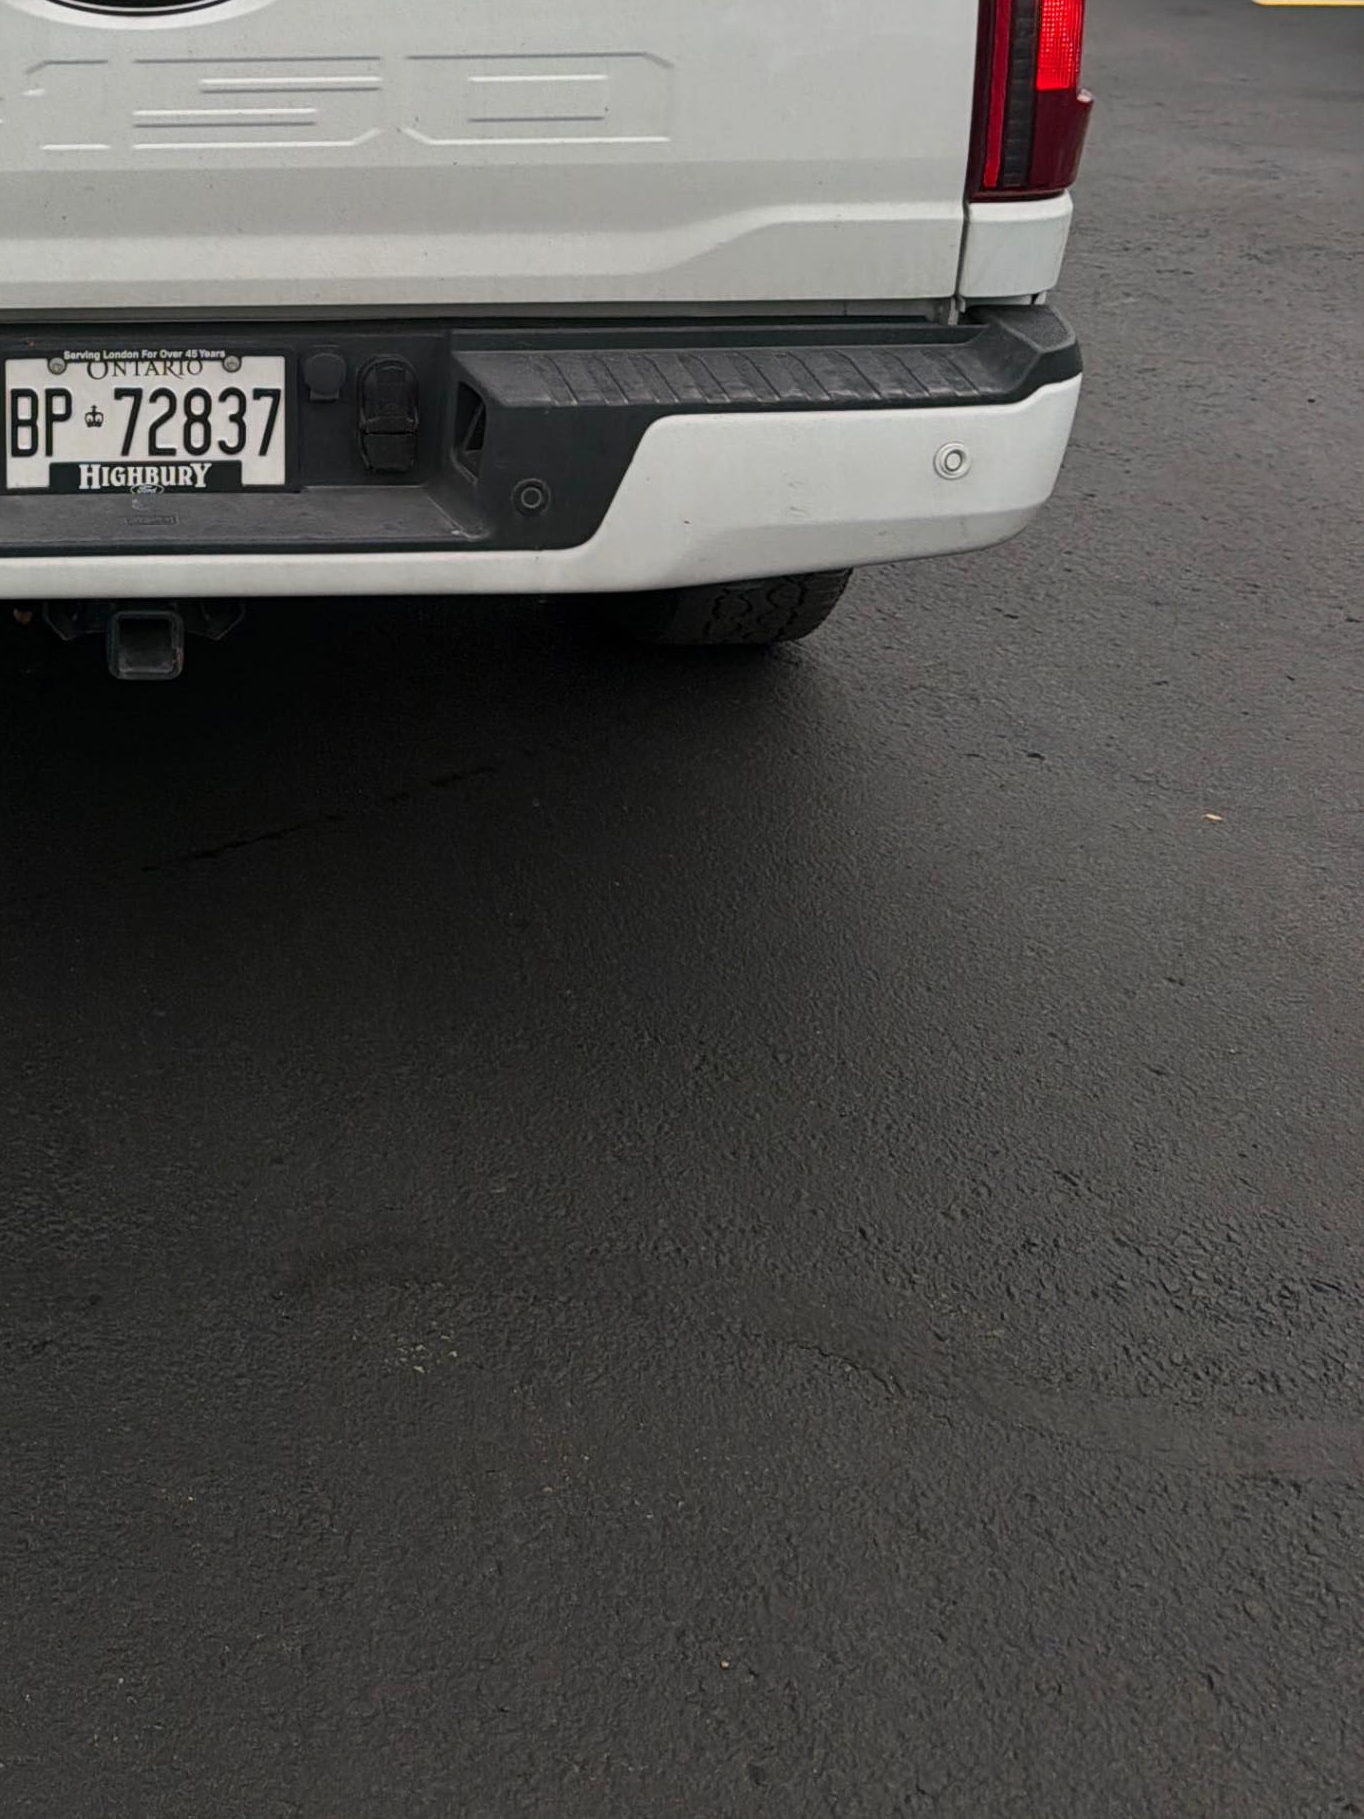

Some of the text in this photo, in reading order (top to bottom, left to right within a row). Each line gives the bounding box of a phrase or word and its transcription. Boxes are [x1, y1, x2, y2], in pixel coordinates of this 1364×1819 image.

[63, 349, 226, 361] Serving London For Over 45 Years
[87, 358, 203, 380] ONTARIO
[10, 387, 283, 457] BP 72837
[79, 463, 212, 489] HIGHBURY
